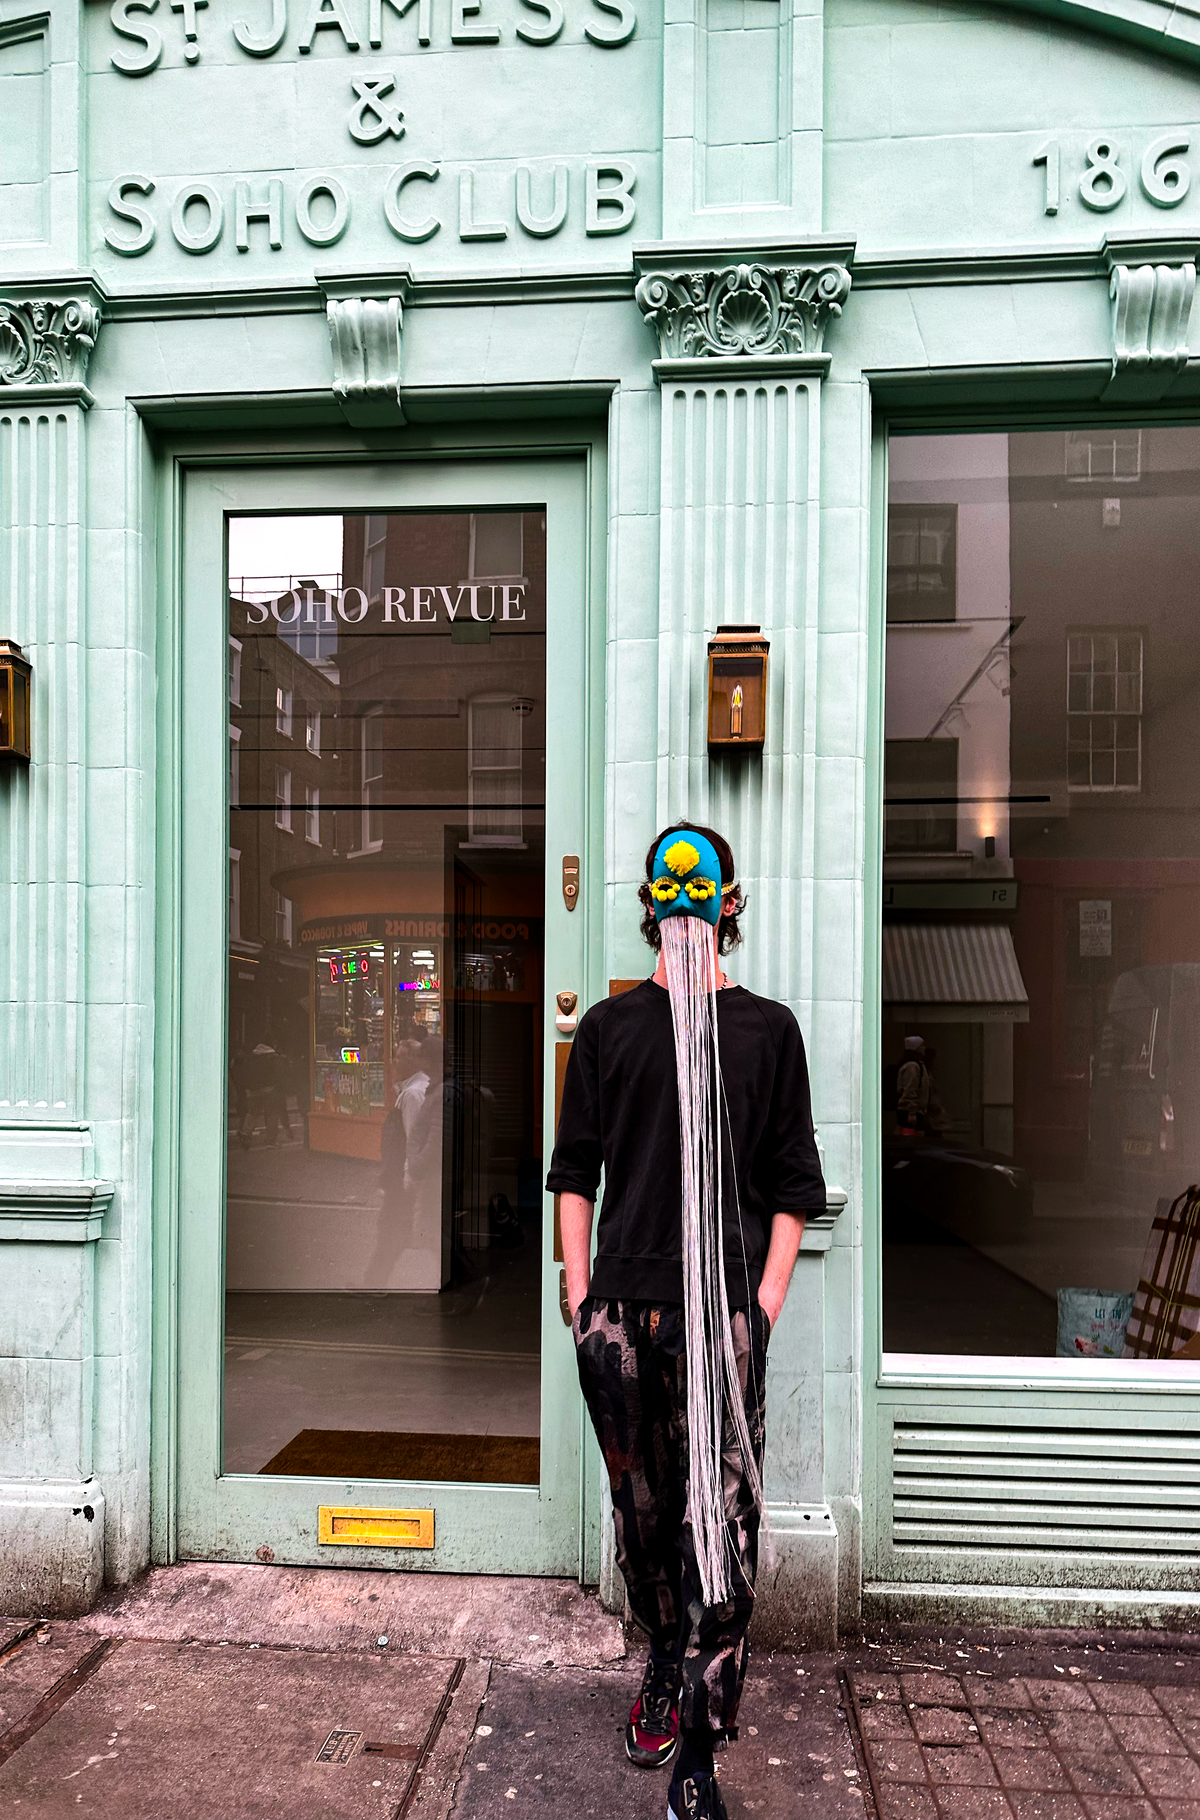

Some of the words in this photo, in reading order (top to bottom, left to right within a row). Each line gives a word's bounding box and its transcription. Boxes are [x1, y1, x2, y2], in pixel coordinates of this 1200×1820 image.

[348, 73, 406, 146] &
[104, 173, 350, 257] SOHO
[383, 160, 638, 243] CLUB
[1032, 132, 1191, 217] 186
[246, 585, 369, 625] SOHO
[381, 584, 526, 623] REVUE
